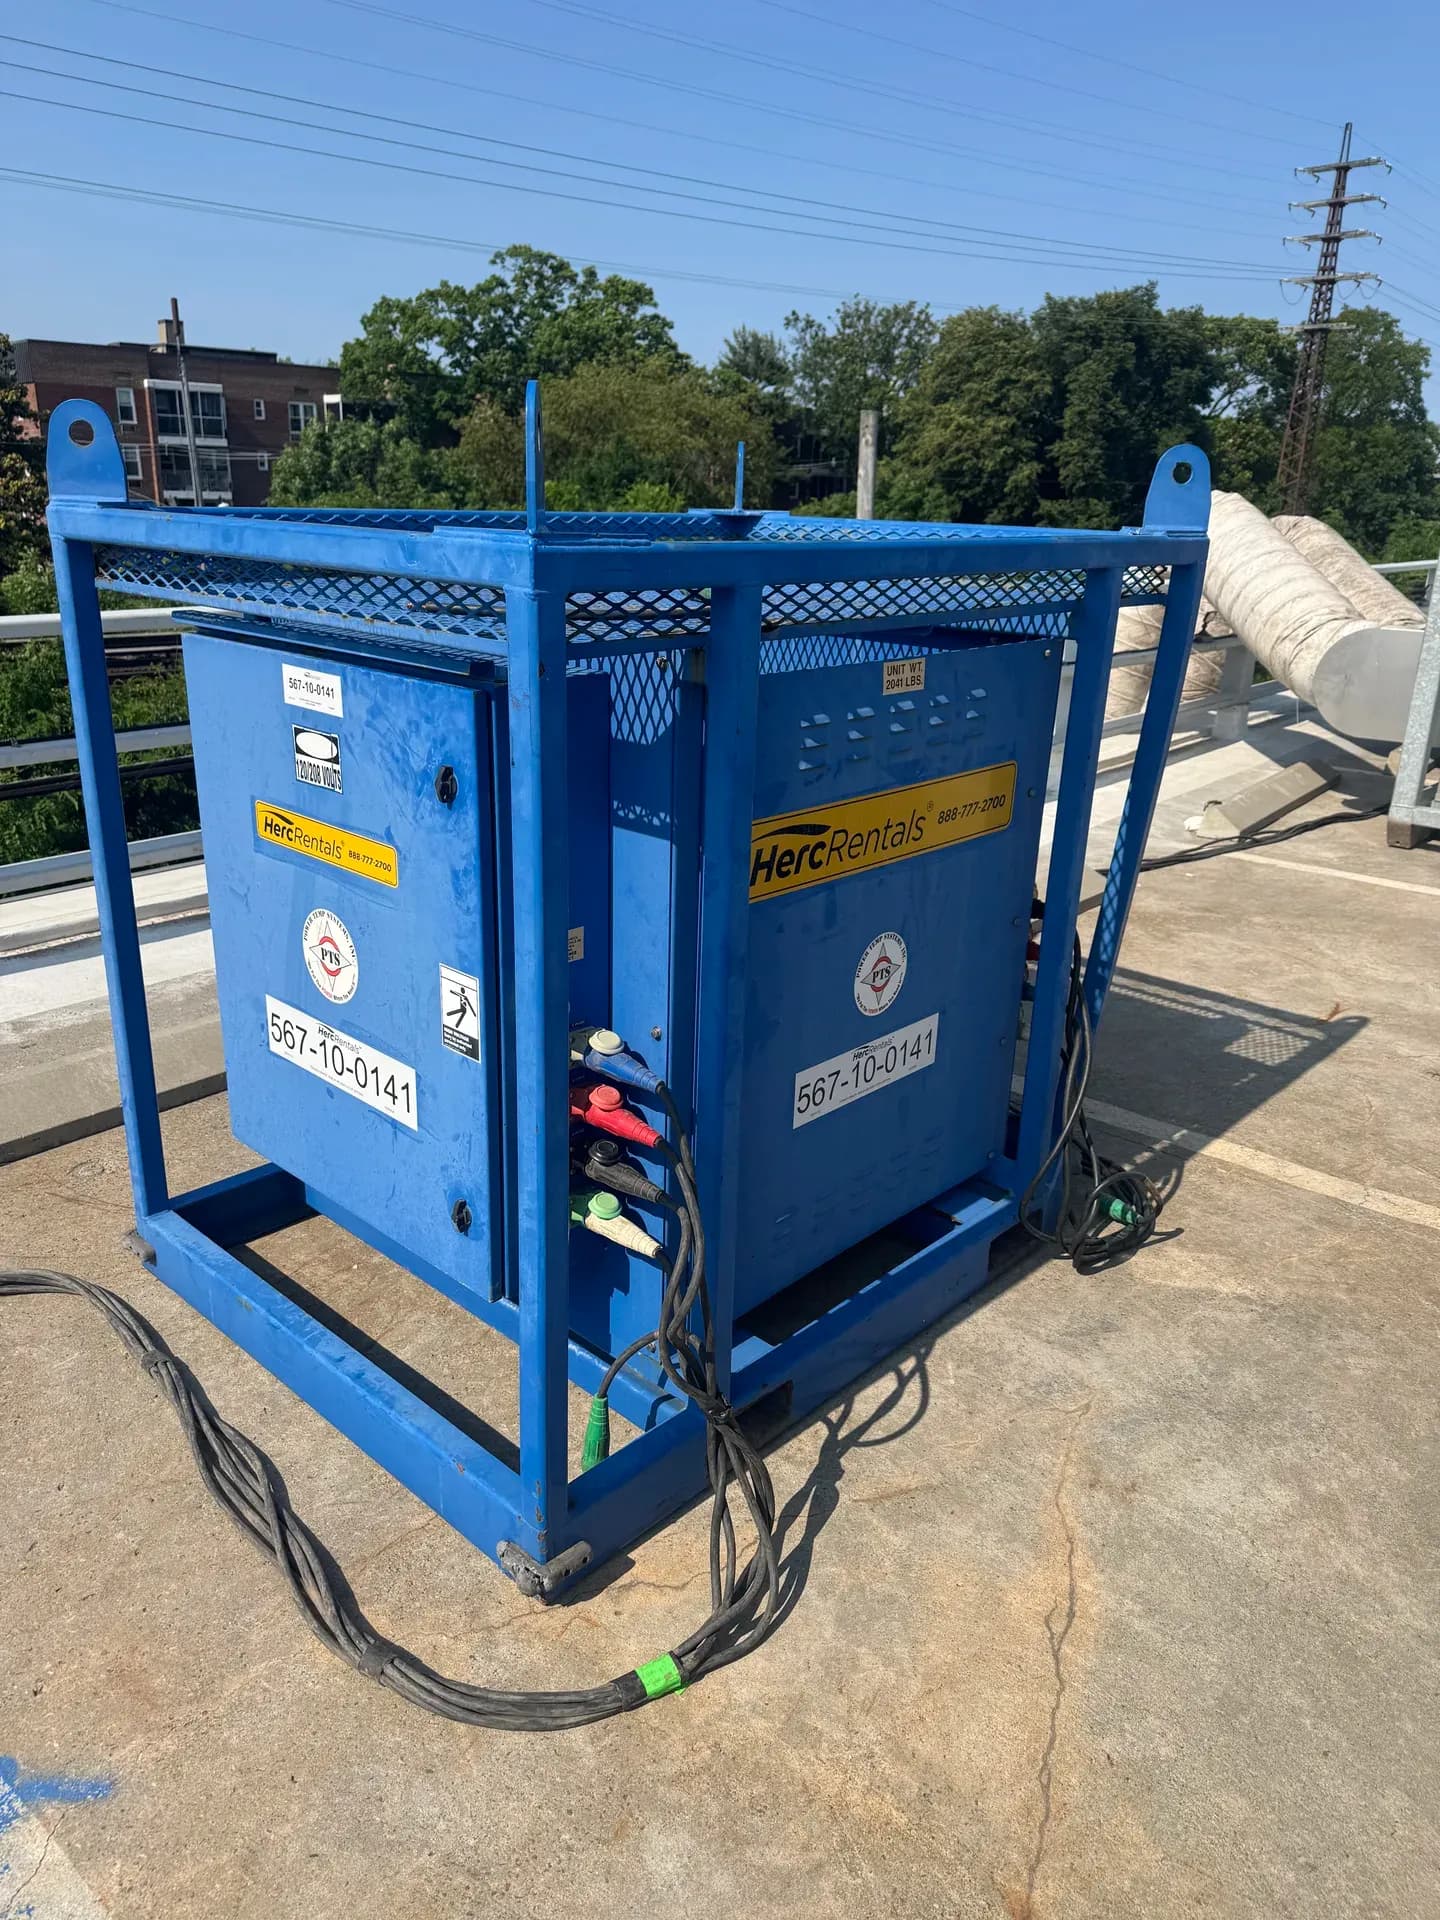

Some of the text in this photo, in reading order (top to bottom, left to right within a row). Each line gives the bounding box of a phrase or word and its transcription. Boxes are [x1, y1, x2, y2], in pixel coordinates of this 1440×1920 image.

[887, 664, 906, 676] UNIT
[288, 677, 336, 700] 567-10-0141
[886, 677, 903, 690] 2041
[295, 758, 343, 792] 120/208 VOLTS
[937, 794, 1007, 826] 888-777-2700
[348, 849, 393, 874] 888-777-2700
[320, 946, 342, 968] PTS
[856, 951, 870, 978] POWER
[871, 965, 892, 984] PTS
[271, 1012, 411, 1114] 567-10-0141
[796, 1028, 933, 1114] 567-10-0141
